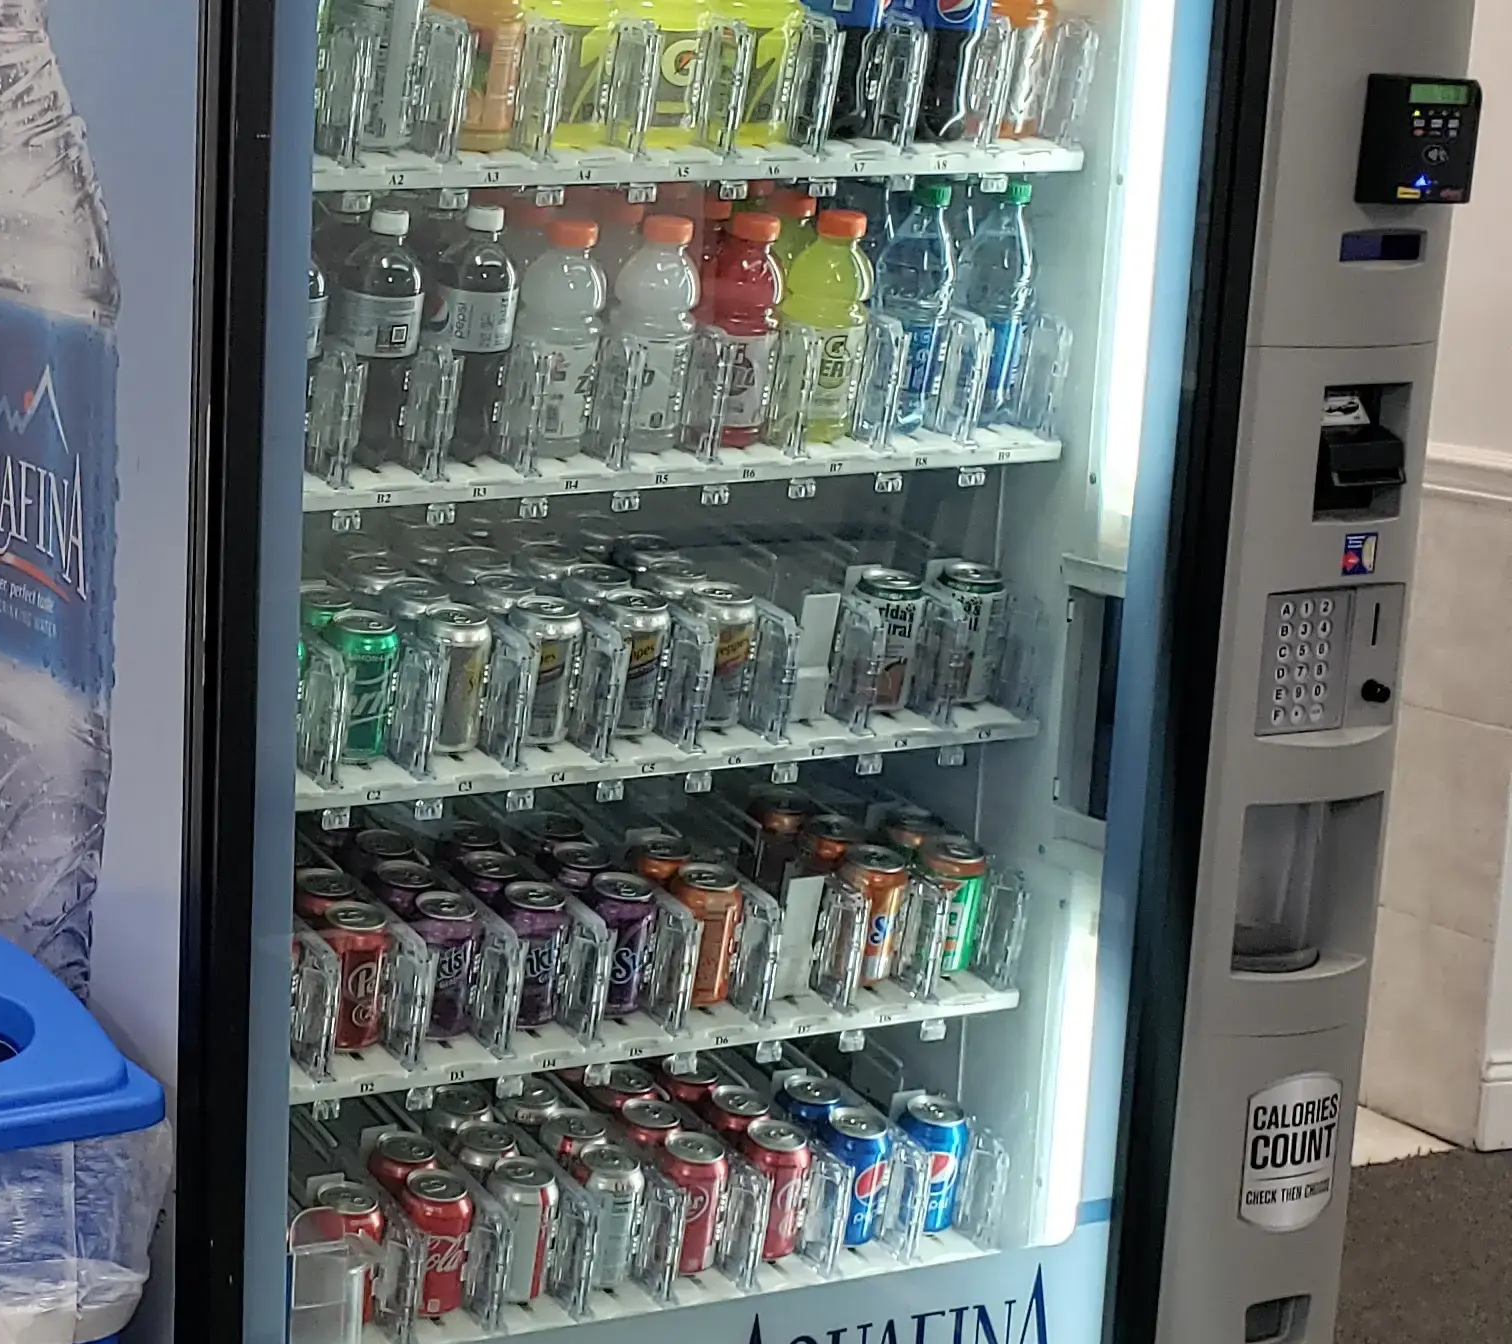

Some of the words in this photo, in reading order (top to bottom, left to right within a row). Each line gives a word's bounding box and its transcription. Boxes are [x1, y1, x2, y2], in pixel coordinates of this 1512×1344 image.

[764, 164, 780, 176] A6
[850, 161, 866, 173] A7
[933, 159, 947, 171] A8
[484, 171, 499, 183] A3
[576, 169, 592, 181] A4
[675, 167, 690, 178] A5
[388, 174, 404, 186] A2
[454, 302, 467, 340] pepsi
[914, 456, 928, 467] B8
[997, 451, 1011, 461] B9
[829, 462, 843, 473] B7
[654, 473, 669, 484] B5
[742, 468, 756, 479] B6
[564, 480, 579, 491] B4
[472, 487, 487, 498] B3
[376, 493, 392, 504] B2
[9, 577, 37, 605] perfect
[811, 747, 825, 757] C7
[727, 756, 742, 765] C6
[641, 763, 655, 774] C5
[551, 772, 565, 783] C4
[366, 790, 382, 801] C2
[797, 1025, 811, 1035] D7
[715, 1035, 729, 1046] D6
[542, 1058, 556, 1069] D4
[450, 1071, 465, 1082] D3
[359, 1082, 375, 1093] D2
[1253, 1094, 1338, 1130] CALORIES
[1250, 1123, 1335, 1169] COUNT
[1245, 1186, 1277, 1206] CHECK
[1280, 1184, 1302, 1202] THEN
